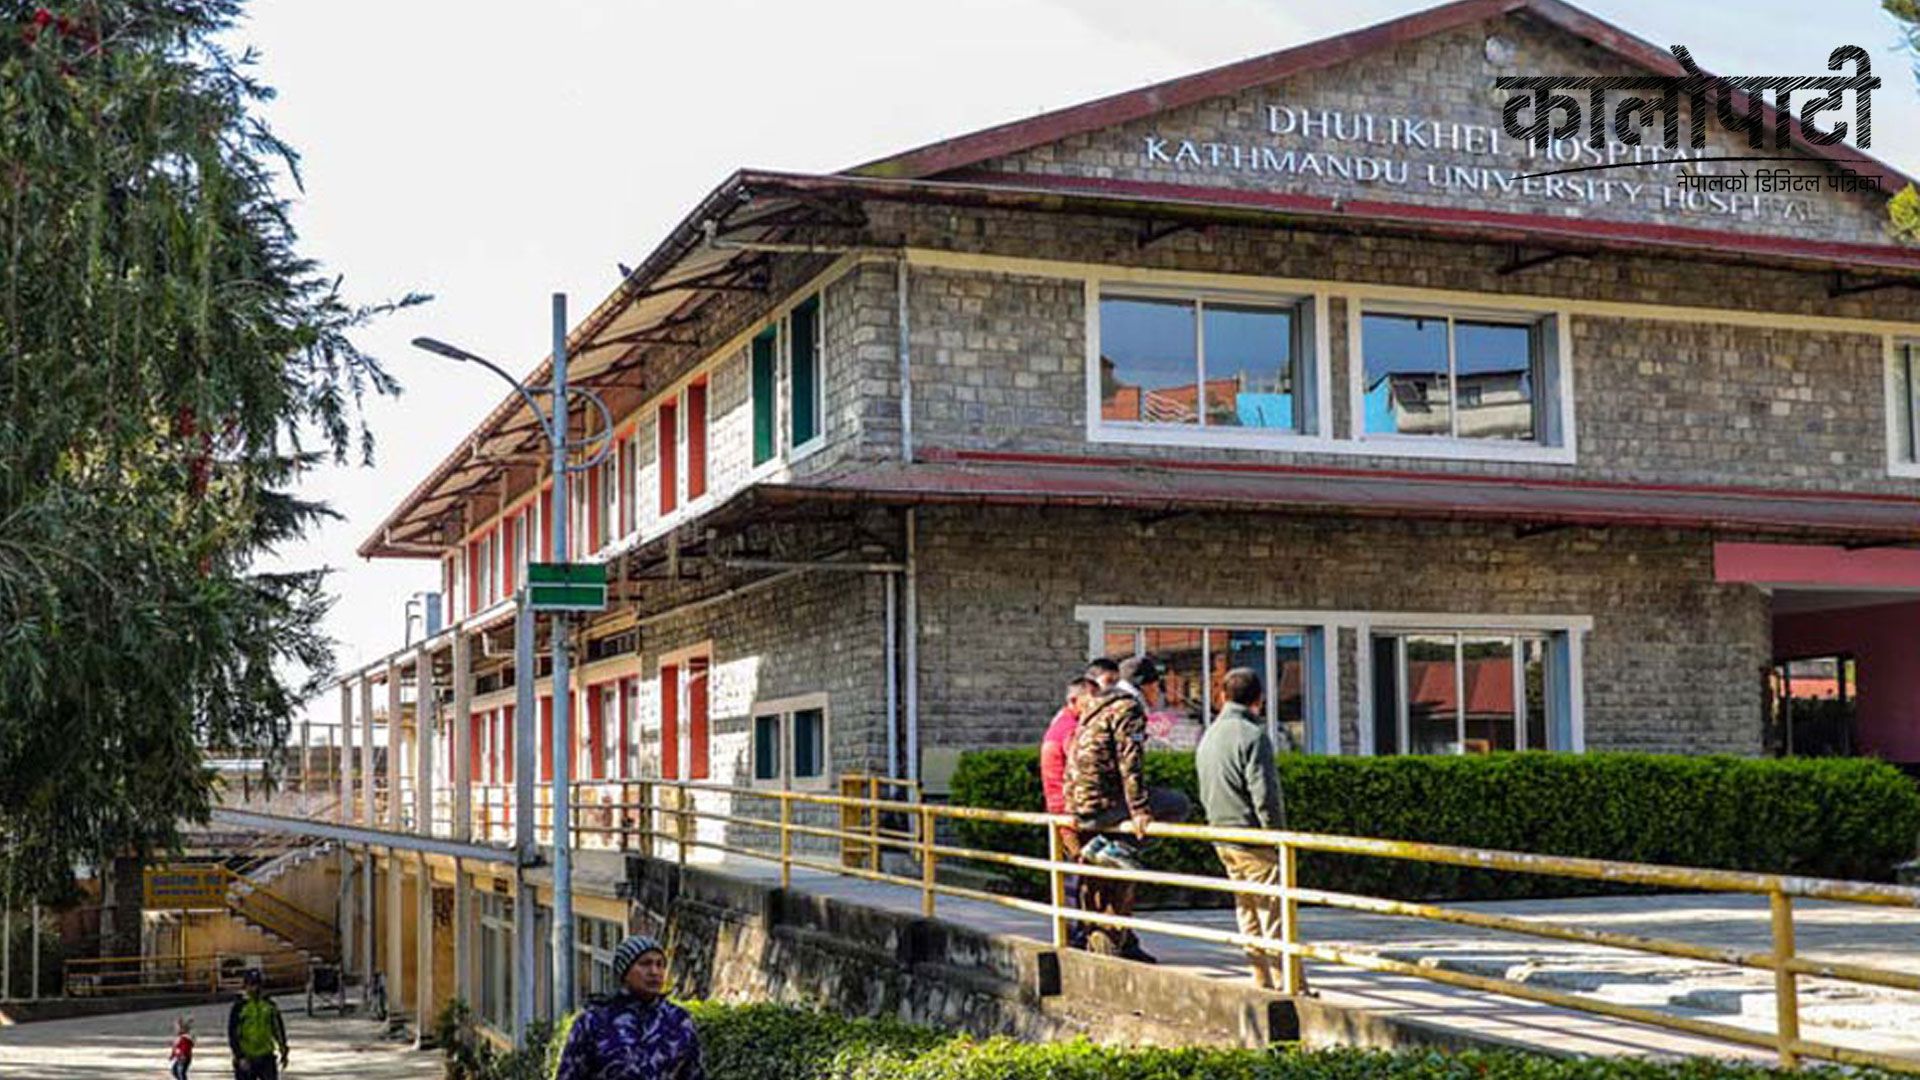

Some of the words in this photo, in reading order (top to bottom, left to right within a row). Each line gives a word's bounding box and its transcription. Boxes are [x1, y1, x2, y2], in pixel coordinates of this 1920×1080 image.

[1266, 104, 1509, 156] DHULIKHEL
[1526, 134, 1715, 175] HOSPITAL
[1145, 136, 1408, 185] KATHMANDU
[1427, 164, 1644, 204] UNIVERSITY
[1663, 185, 1826, 222] HOSPIAL
